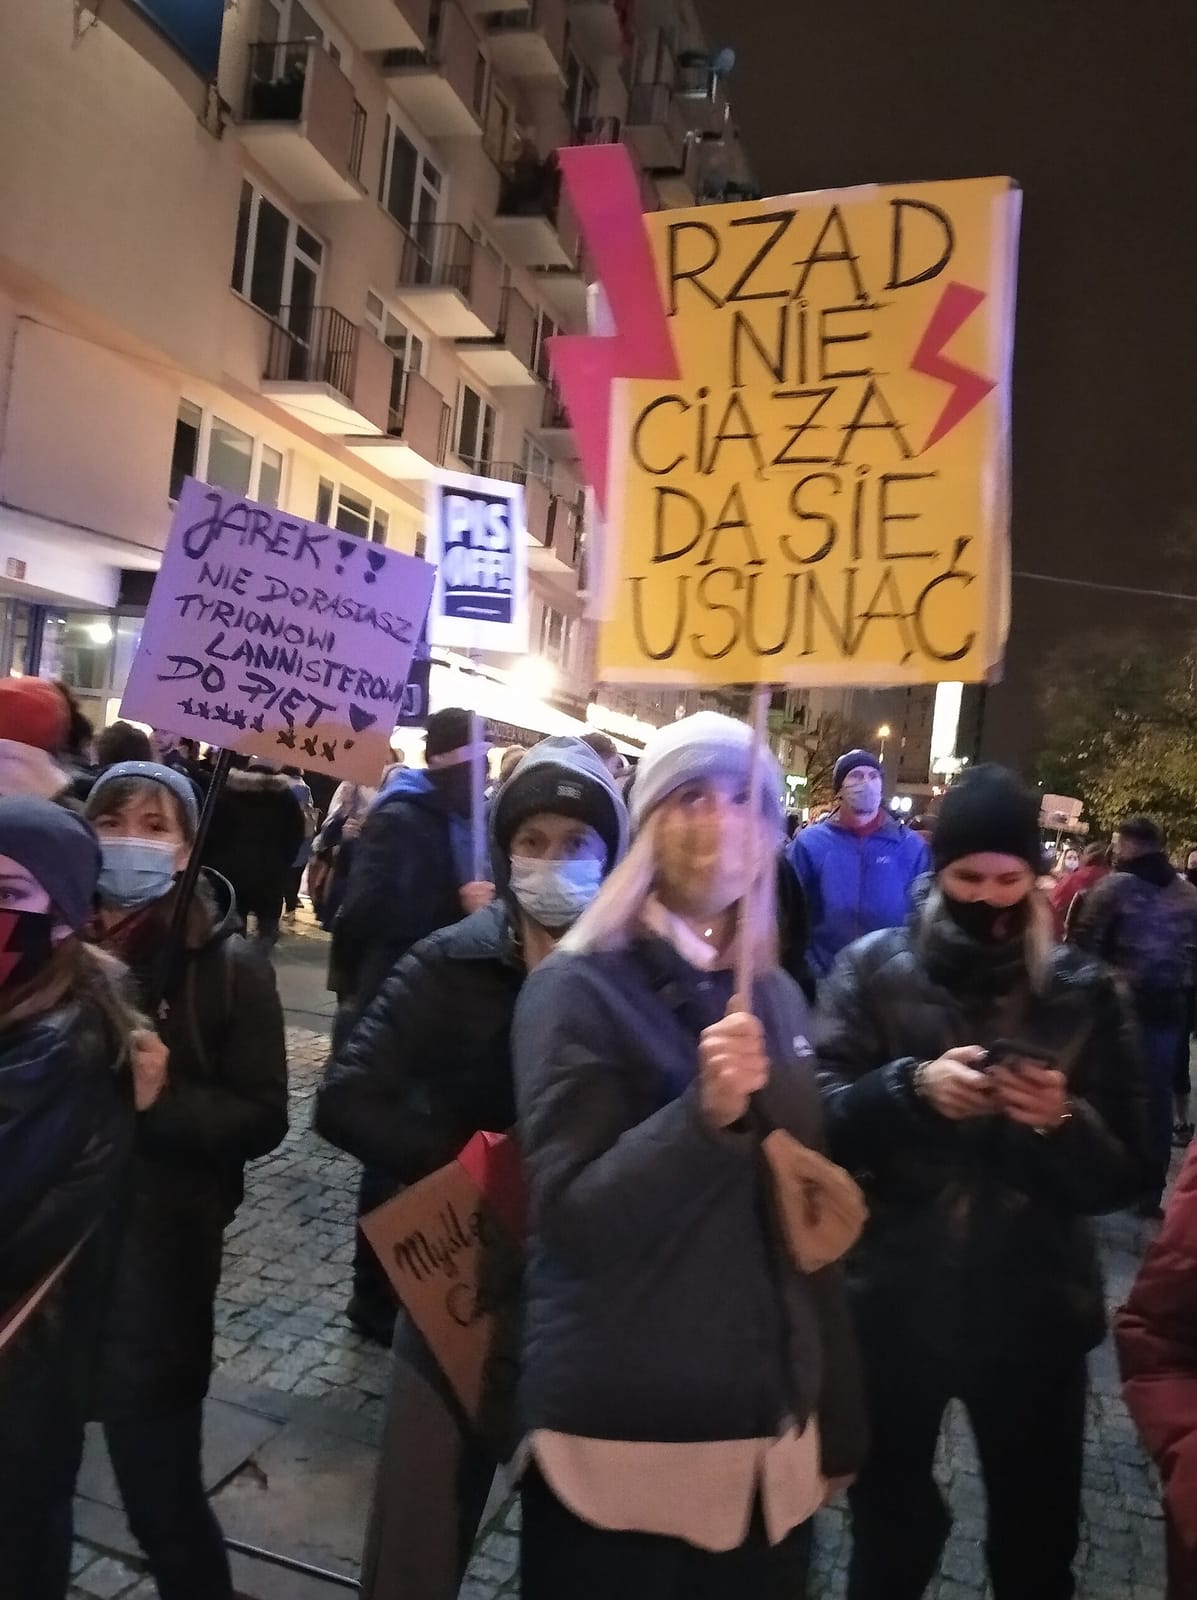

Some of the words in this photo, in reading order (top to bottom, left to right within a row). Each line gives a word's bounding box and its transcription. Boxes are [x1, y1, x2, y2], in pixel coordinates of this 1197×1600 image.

[651, 483, 766, 566] DA
[197, 561, 253, 595] NIE
[175, 593, 335, 652] TYRIONOWI
[157, 655, 226, 693] DO
